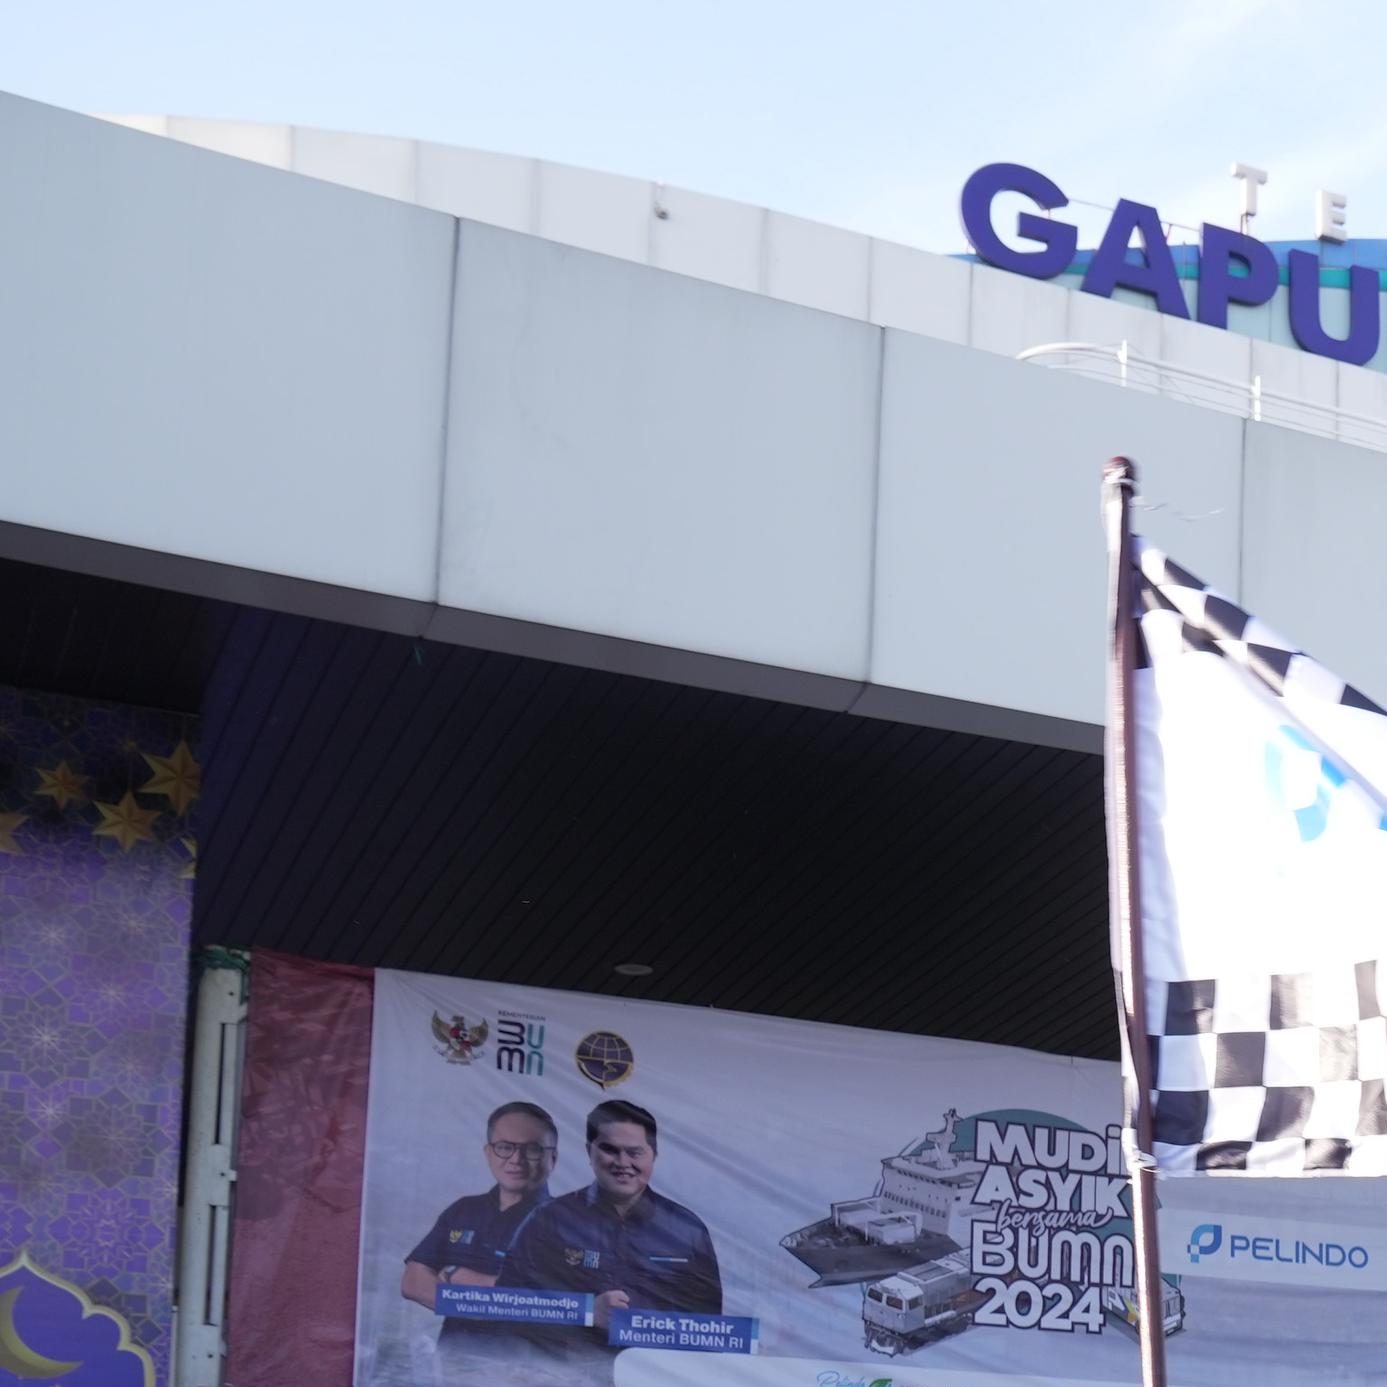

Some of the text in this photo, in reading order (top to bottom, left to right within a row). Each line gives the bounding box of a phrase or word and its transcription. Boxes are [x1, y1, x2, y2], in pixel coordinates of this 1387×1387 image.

[974, 1118, 1124, 1177] MUDI
[970, 1164, 1133, 1218] ASYIK
[996, 1199, 1115, 1236] bersama
[1231, 1234, 1369, 1269] PELINDO
[442, 1289, 579, 1309] Kartika Wirjoatmodjo
[456, 1303, 578, 1320] Wakil Menteri BUMN RI
[972, 1277, 1106, 1334] 2024
[619, 1329, 744, 1349] Menteri BUMN RI
[631, 1315, 734, 1334] Erick Thohir
